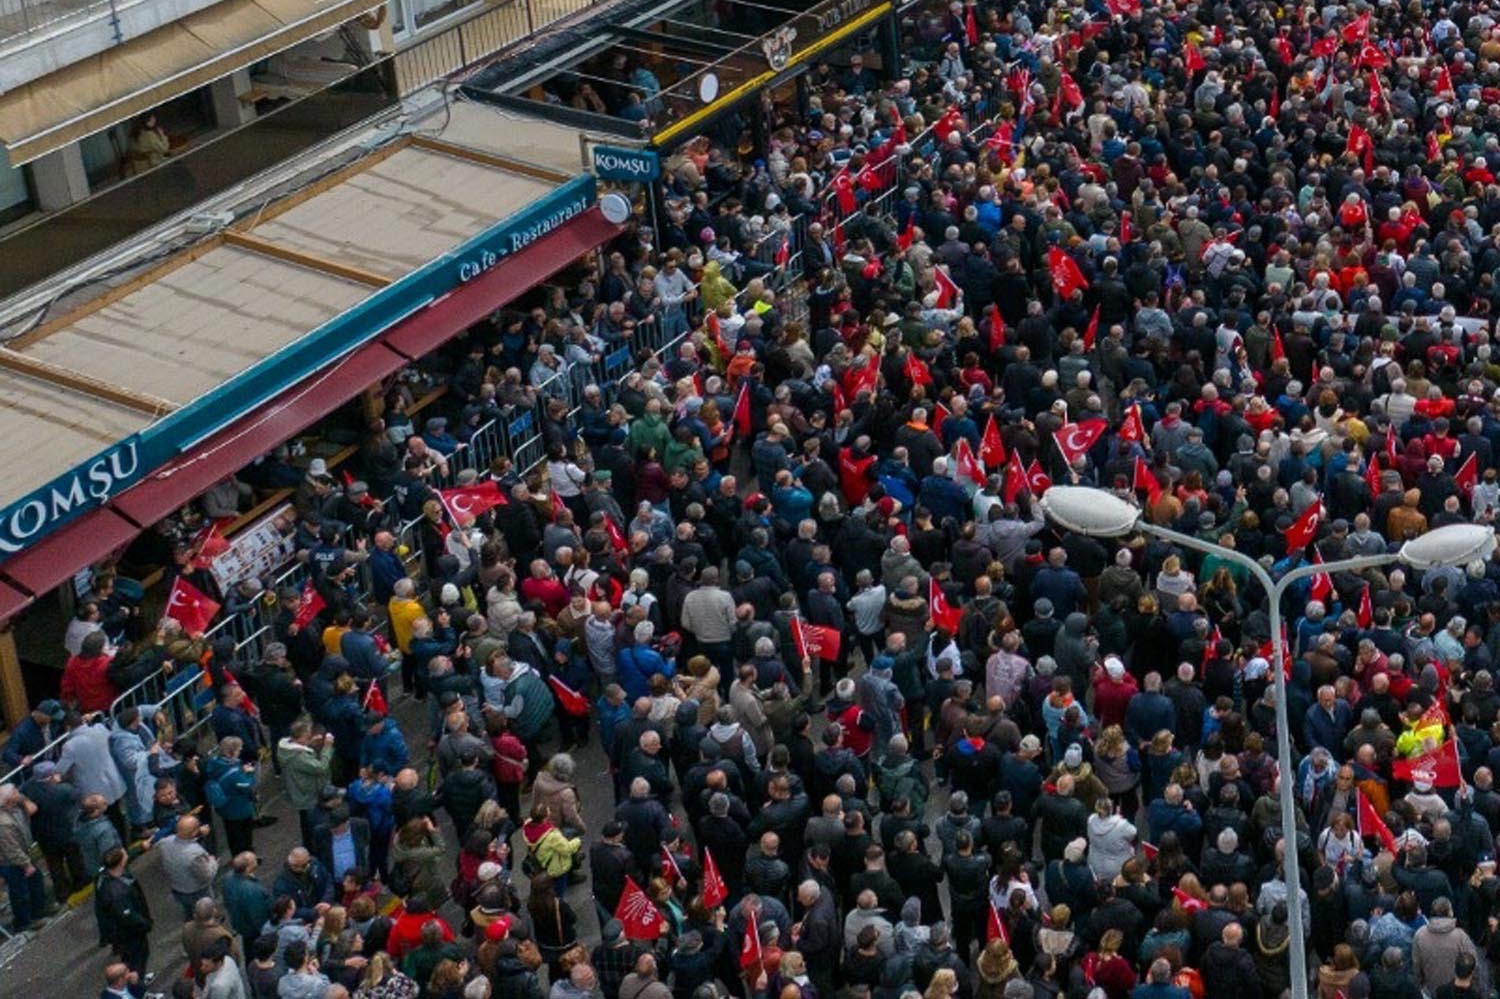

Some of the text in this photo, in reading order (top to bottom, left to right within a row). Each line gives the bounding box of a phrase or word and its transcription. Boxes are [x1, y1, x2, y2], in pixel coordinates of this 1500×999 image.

[596, 153, 650, 176] KOMŞU
[460, 249, 496, 282] Cafe
[511, 197, 587, 252] Restaurant
